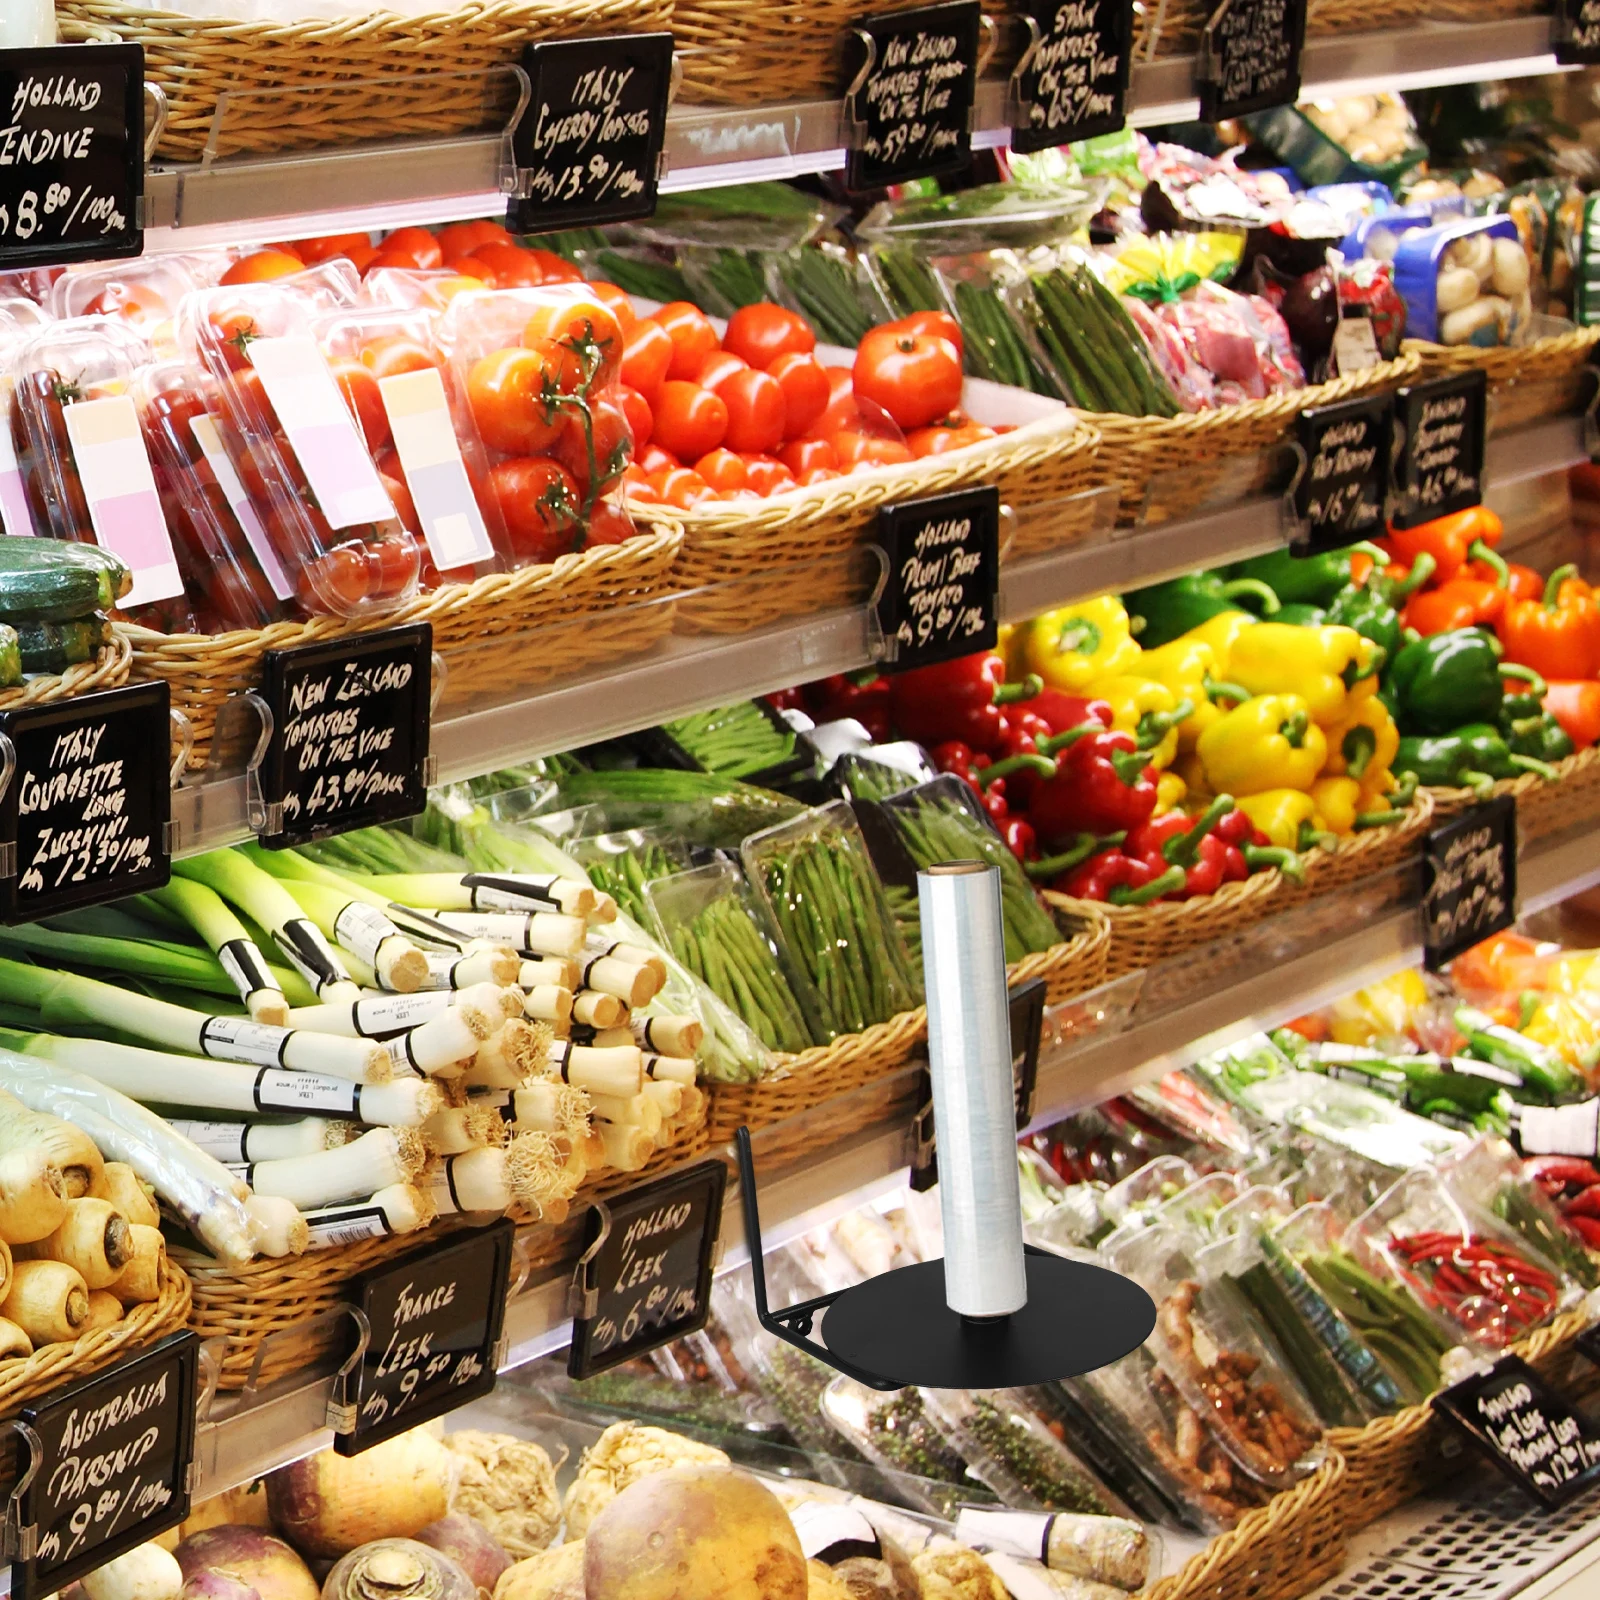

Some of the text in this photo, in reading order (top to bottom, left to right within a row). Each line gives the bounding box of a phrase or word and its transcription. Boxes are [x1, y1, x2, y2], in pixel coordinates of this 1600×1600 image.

[12, 76, 101, 124] HOLLAND
[571, 65, 634, 105] ITALY
[0, 125, 94, 165] ENDIVE
[534, 102, 600, 160] CHERRY
[914, 518, 971, 560] HOLLAND
[909, 584, 963, 617] TOMATO
[289, 674, 331, 715] NEW
[49, 723, 106, 768] ITALY
[284, 707, 360, 751] TOMATOES
[299, 726, 395, 772] ON THE VINE
[19, 760, 123, 815] COURGETTE
[82, 789, 126, 821] LONG
[32, 815, 128, 865] ZUCCHINI
[622, 1202, 692, 1261] HOLLAND
[613, 1249, 668, 1294] LEEK
[394, 1282, 456, 1328] FRANCE
[374, 1330, 434, 1378] LEEK
[58, 1371, 169, 1457] AUSTRALIA
[47, 1426, 159, 1508] PARSNIP
